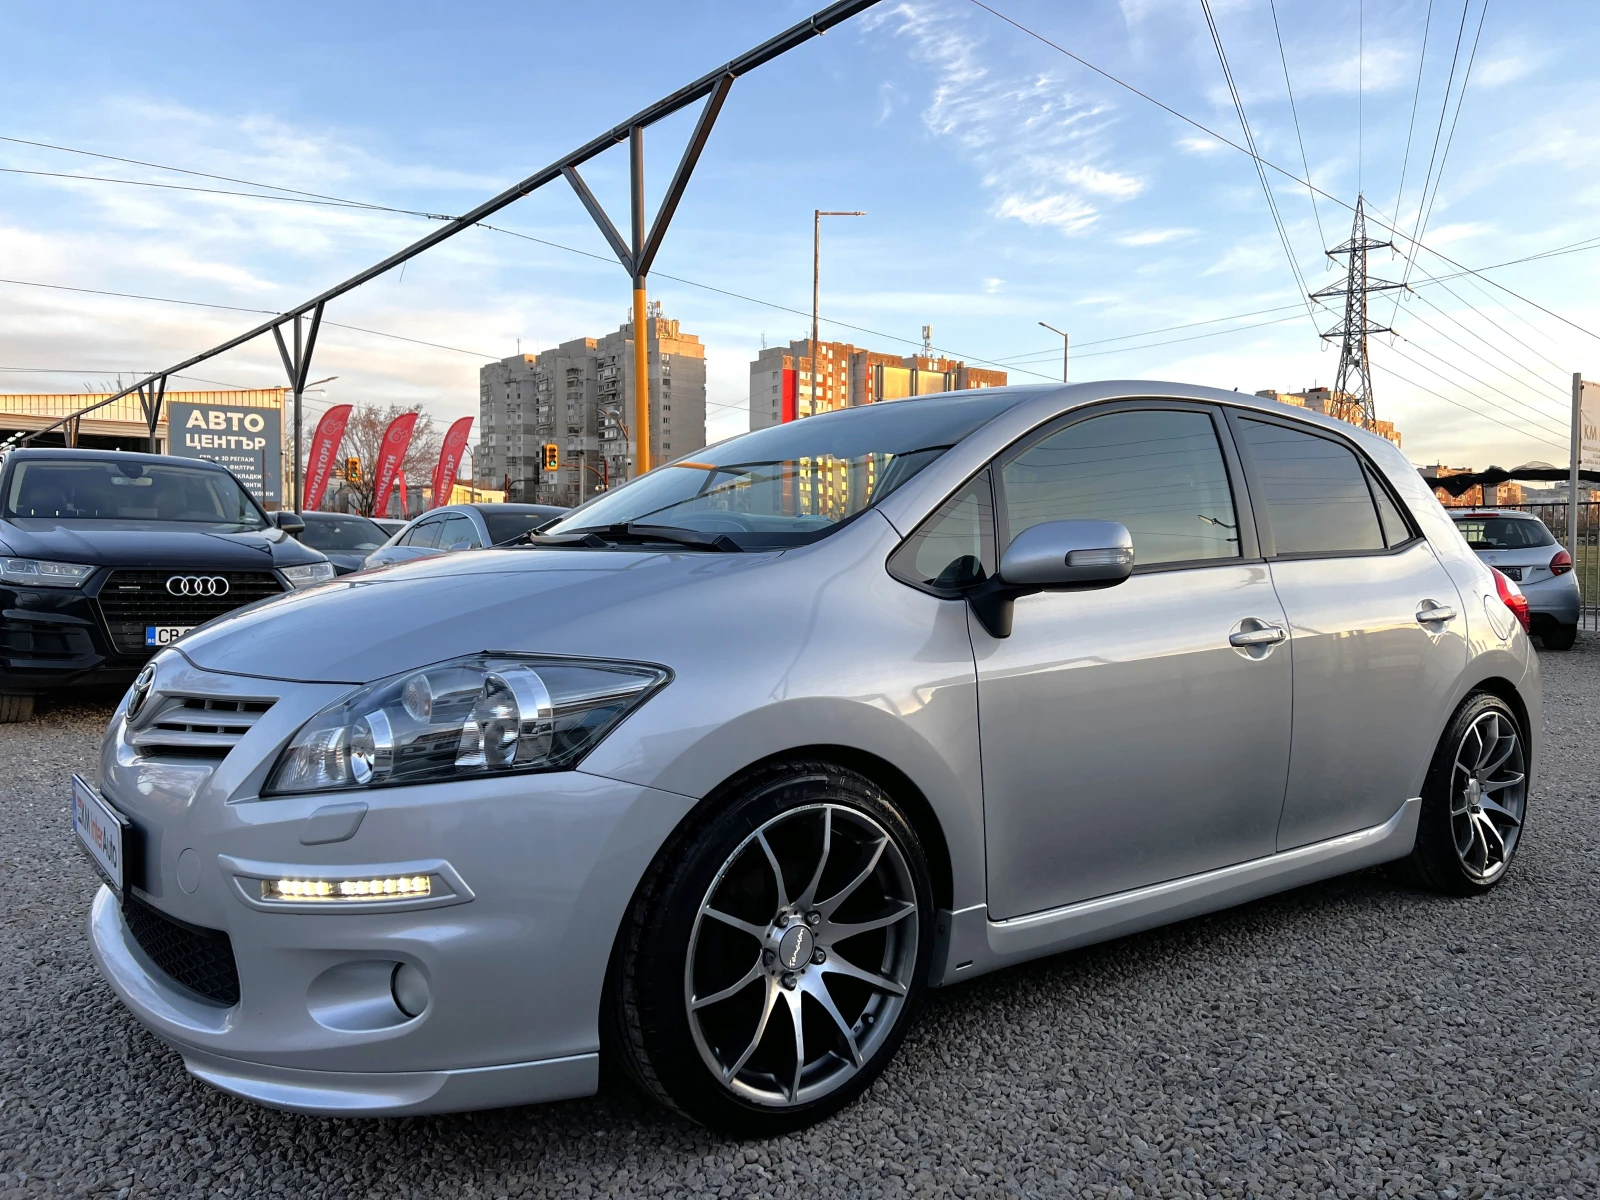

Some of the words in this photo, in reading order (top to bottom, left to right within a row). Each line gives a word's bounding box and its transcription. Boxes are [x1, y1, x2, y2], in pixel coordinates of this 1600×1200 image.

[185, 409, 264, 432] АВТО
[185, 433, 266, 450] ЦЕНТЪР
[306, 439, 332, 511] КУМУЛАТОРИ
